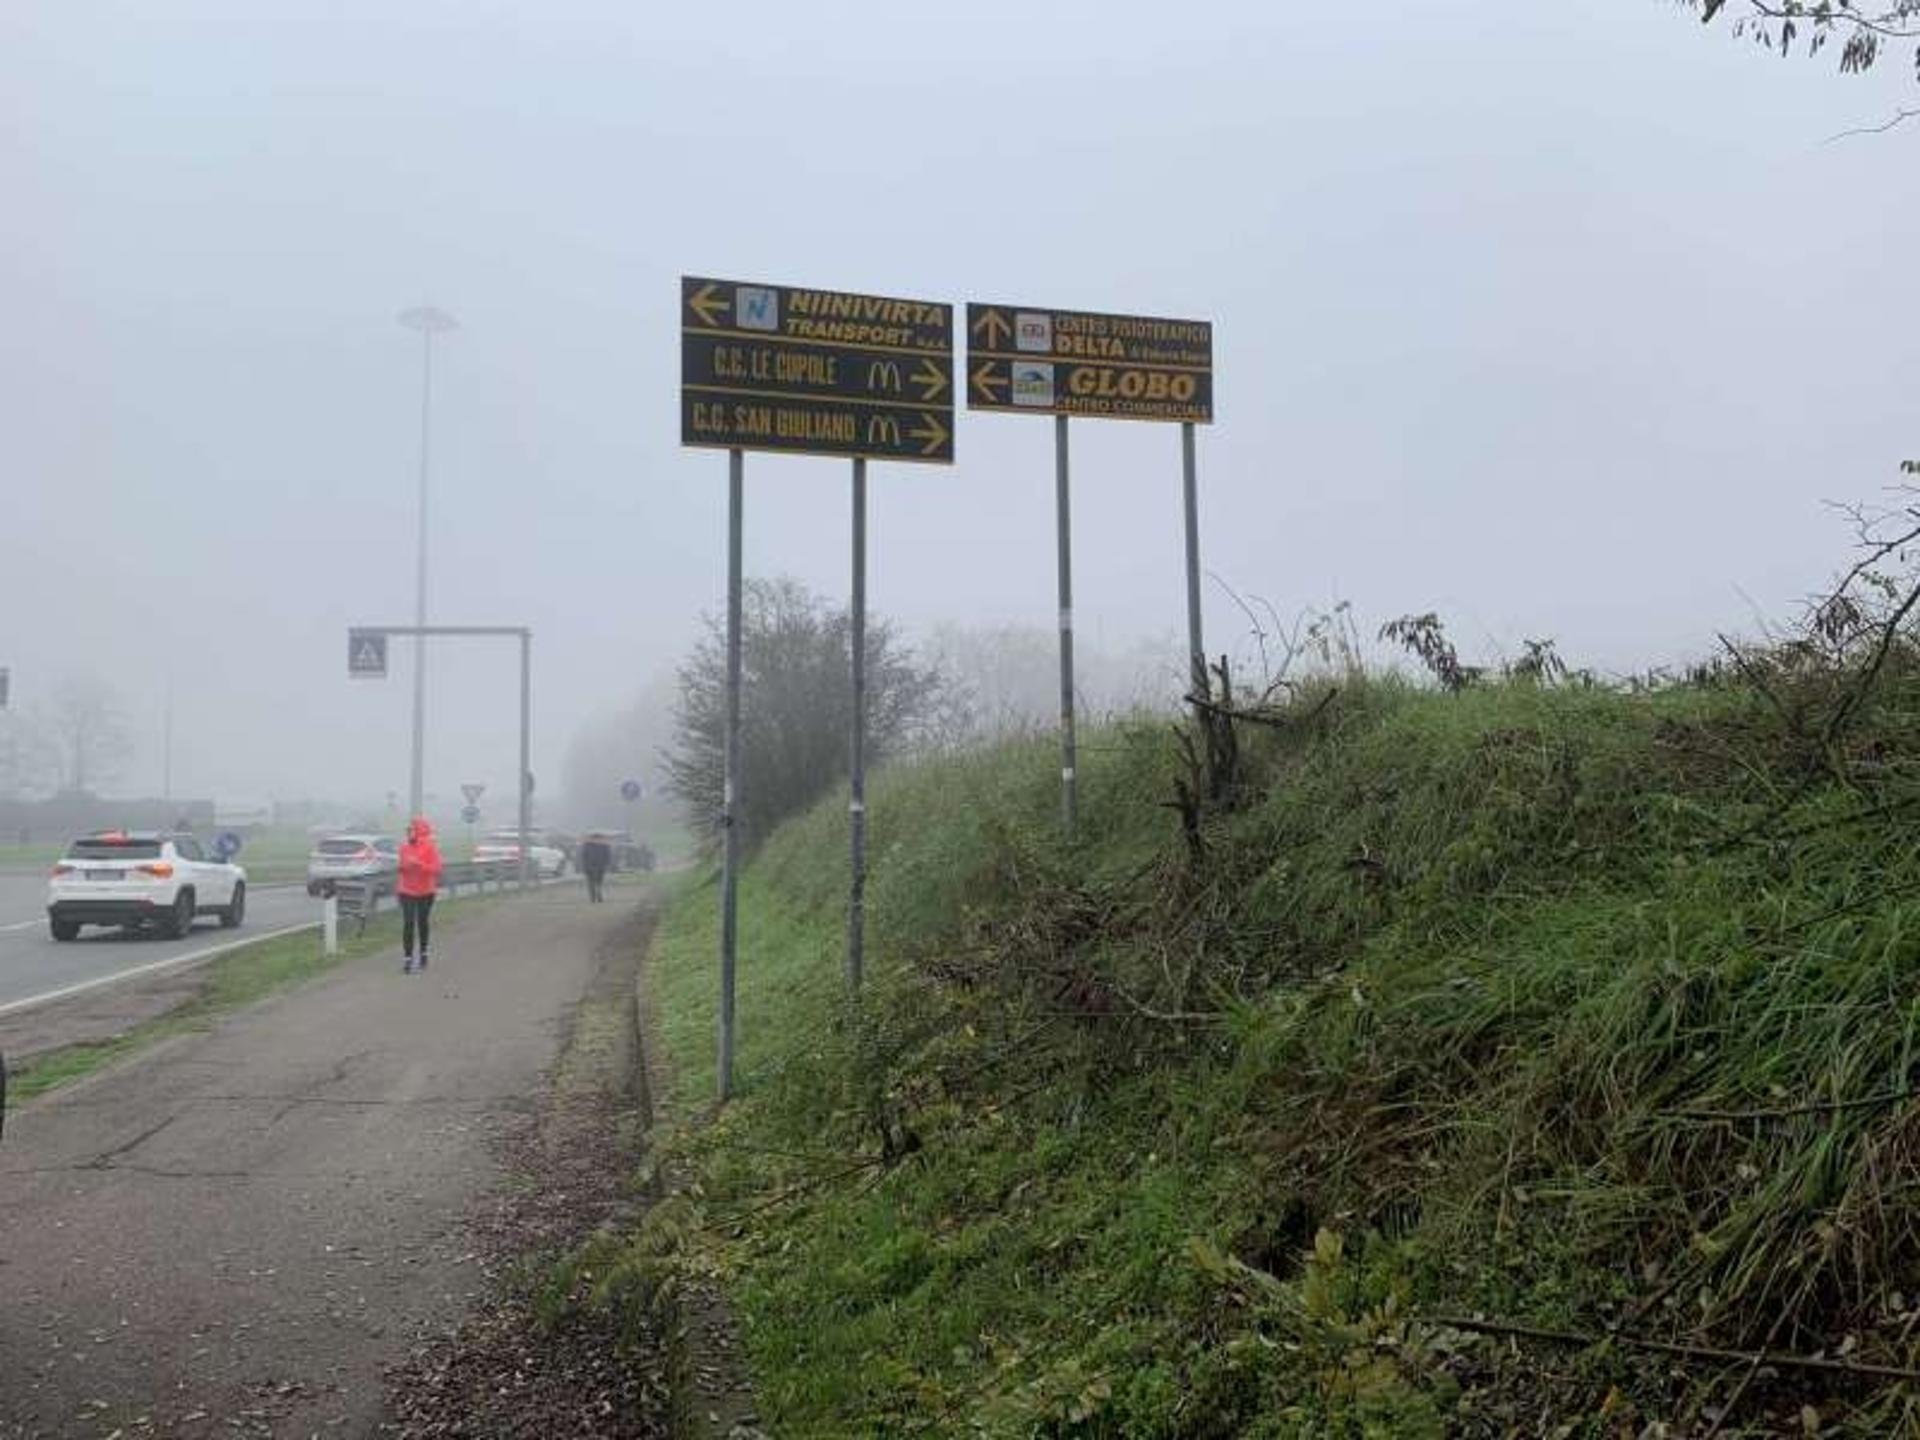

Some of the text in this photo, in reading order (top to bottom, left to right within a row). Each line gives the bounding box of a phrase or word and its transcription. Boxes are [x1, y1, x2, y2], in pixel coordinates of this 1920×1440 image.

[788, 290, 945, 326] NIINIVIRTA
[786, 318, 914, 344] TRANSPORT
[1056, 335, 1125, 357] DELTA
[753, 347, 771, 379] LE
[776, 350, 836, 384] CUPOLE
[1070, 366, 1196, 400] GLOBO
[1056, 395, 1110, 415] CENTRO
[735, 405, 771, 435] SAN
[776, 407, 856, 442] GIULIANO
